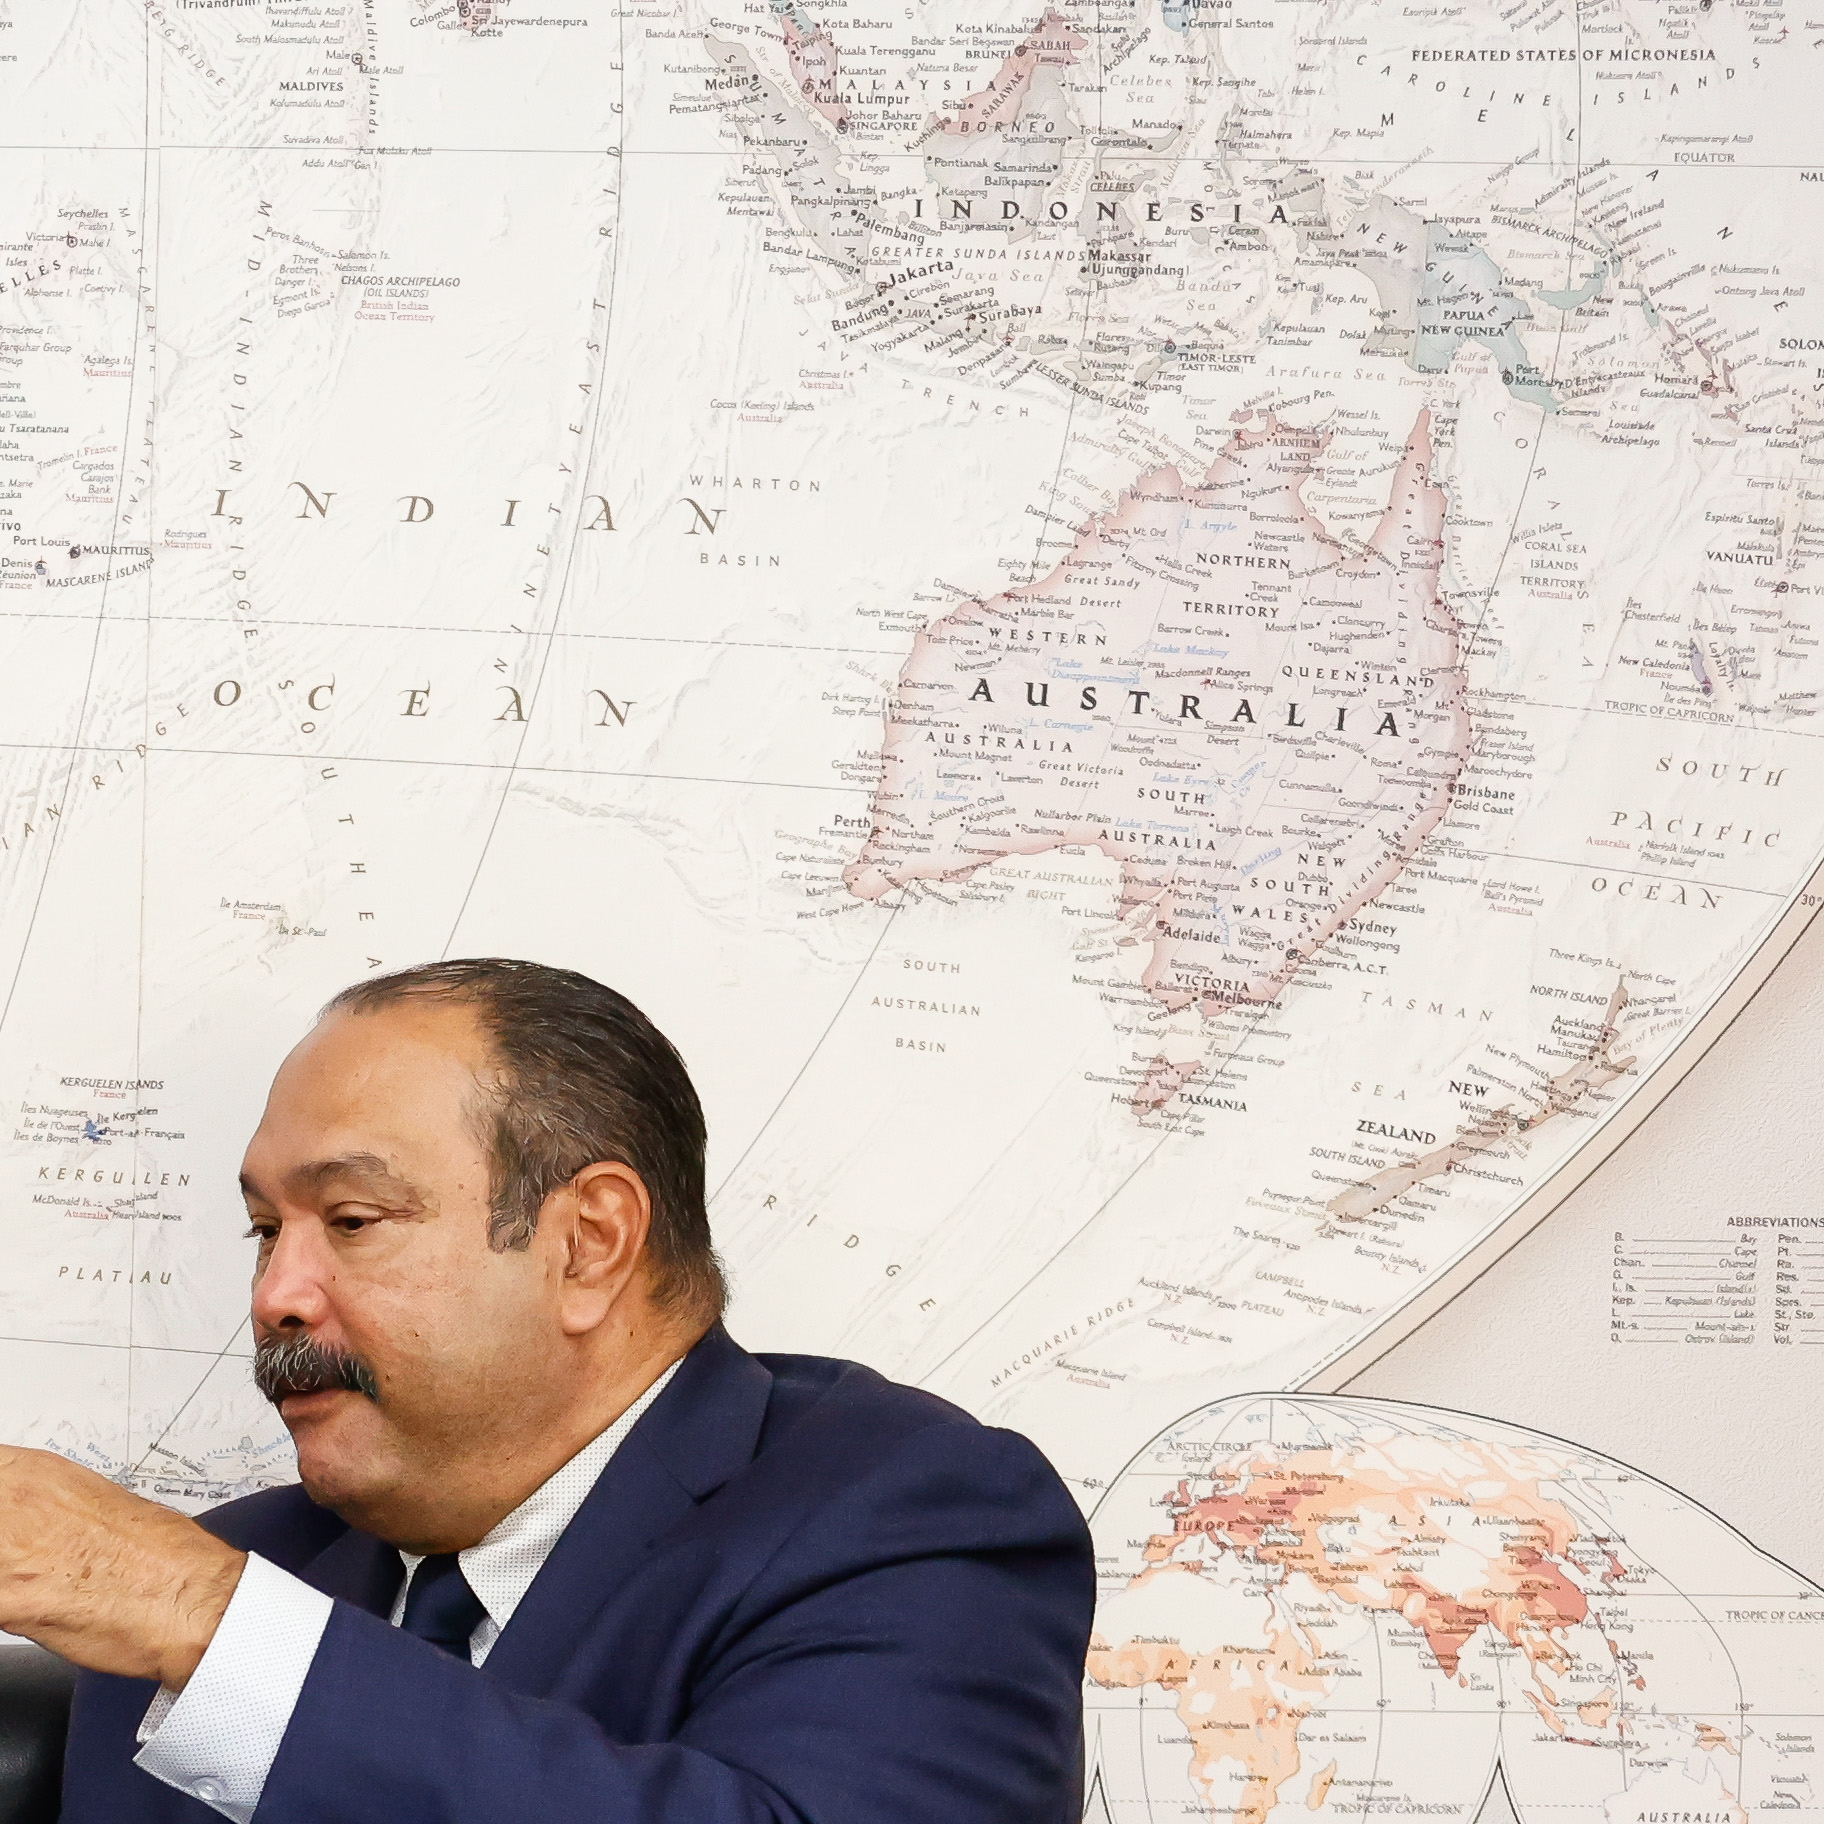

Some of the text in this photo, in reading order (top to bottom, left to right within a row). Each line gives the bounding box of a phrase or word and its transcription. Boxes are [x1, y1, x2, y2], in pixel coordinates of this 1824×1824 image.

[1412, 48, 1715, 61] FEDERATED STATES OF MICRONESIA
[279, 82, 343, 91] MALDIVES
[814, 91, 910, 107] Kuala Lumpur
[914, 200, 1286, 221] INDONESIA
[690, 476, 822, 491] WHARTON
[211, 482, 727, 536] INDIAN
[700, 553, 782, 567] BASIN
[1196, 552, 1291, 570] NORTHERN
[1183, 601, 1280, 618] TERRITORY
[211, 677, 638, 729] OCEAN
[968, 678, 1399, 739] AUSTRALIA
[1656, 756, 1786, 788] SOUTH
[1456, 784, 1515, 802] Brisbane
[834, 815, 870, 828] Perth
[1610, 810, 1781, 848] PACIFIC
[1591, 877, 1723, 909] OCEAN
[1349, 919, 1397, 939] Sydney
[1449, 1081, 1489, 1097] NEW
[1356, 1120, 1436, 1146] ZEALAND
[1727, 1217, 1824, 1228] ABBREVIATIONS
[1636, 1812, 1731, 1823] AUSTRALIA
